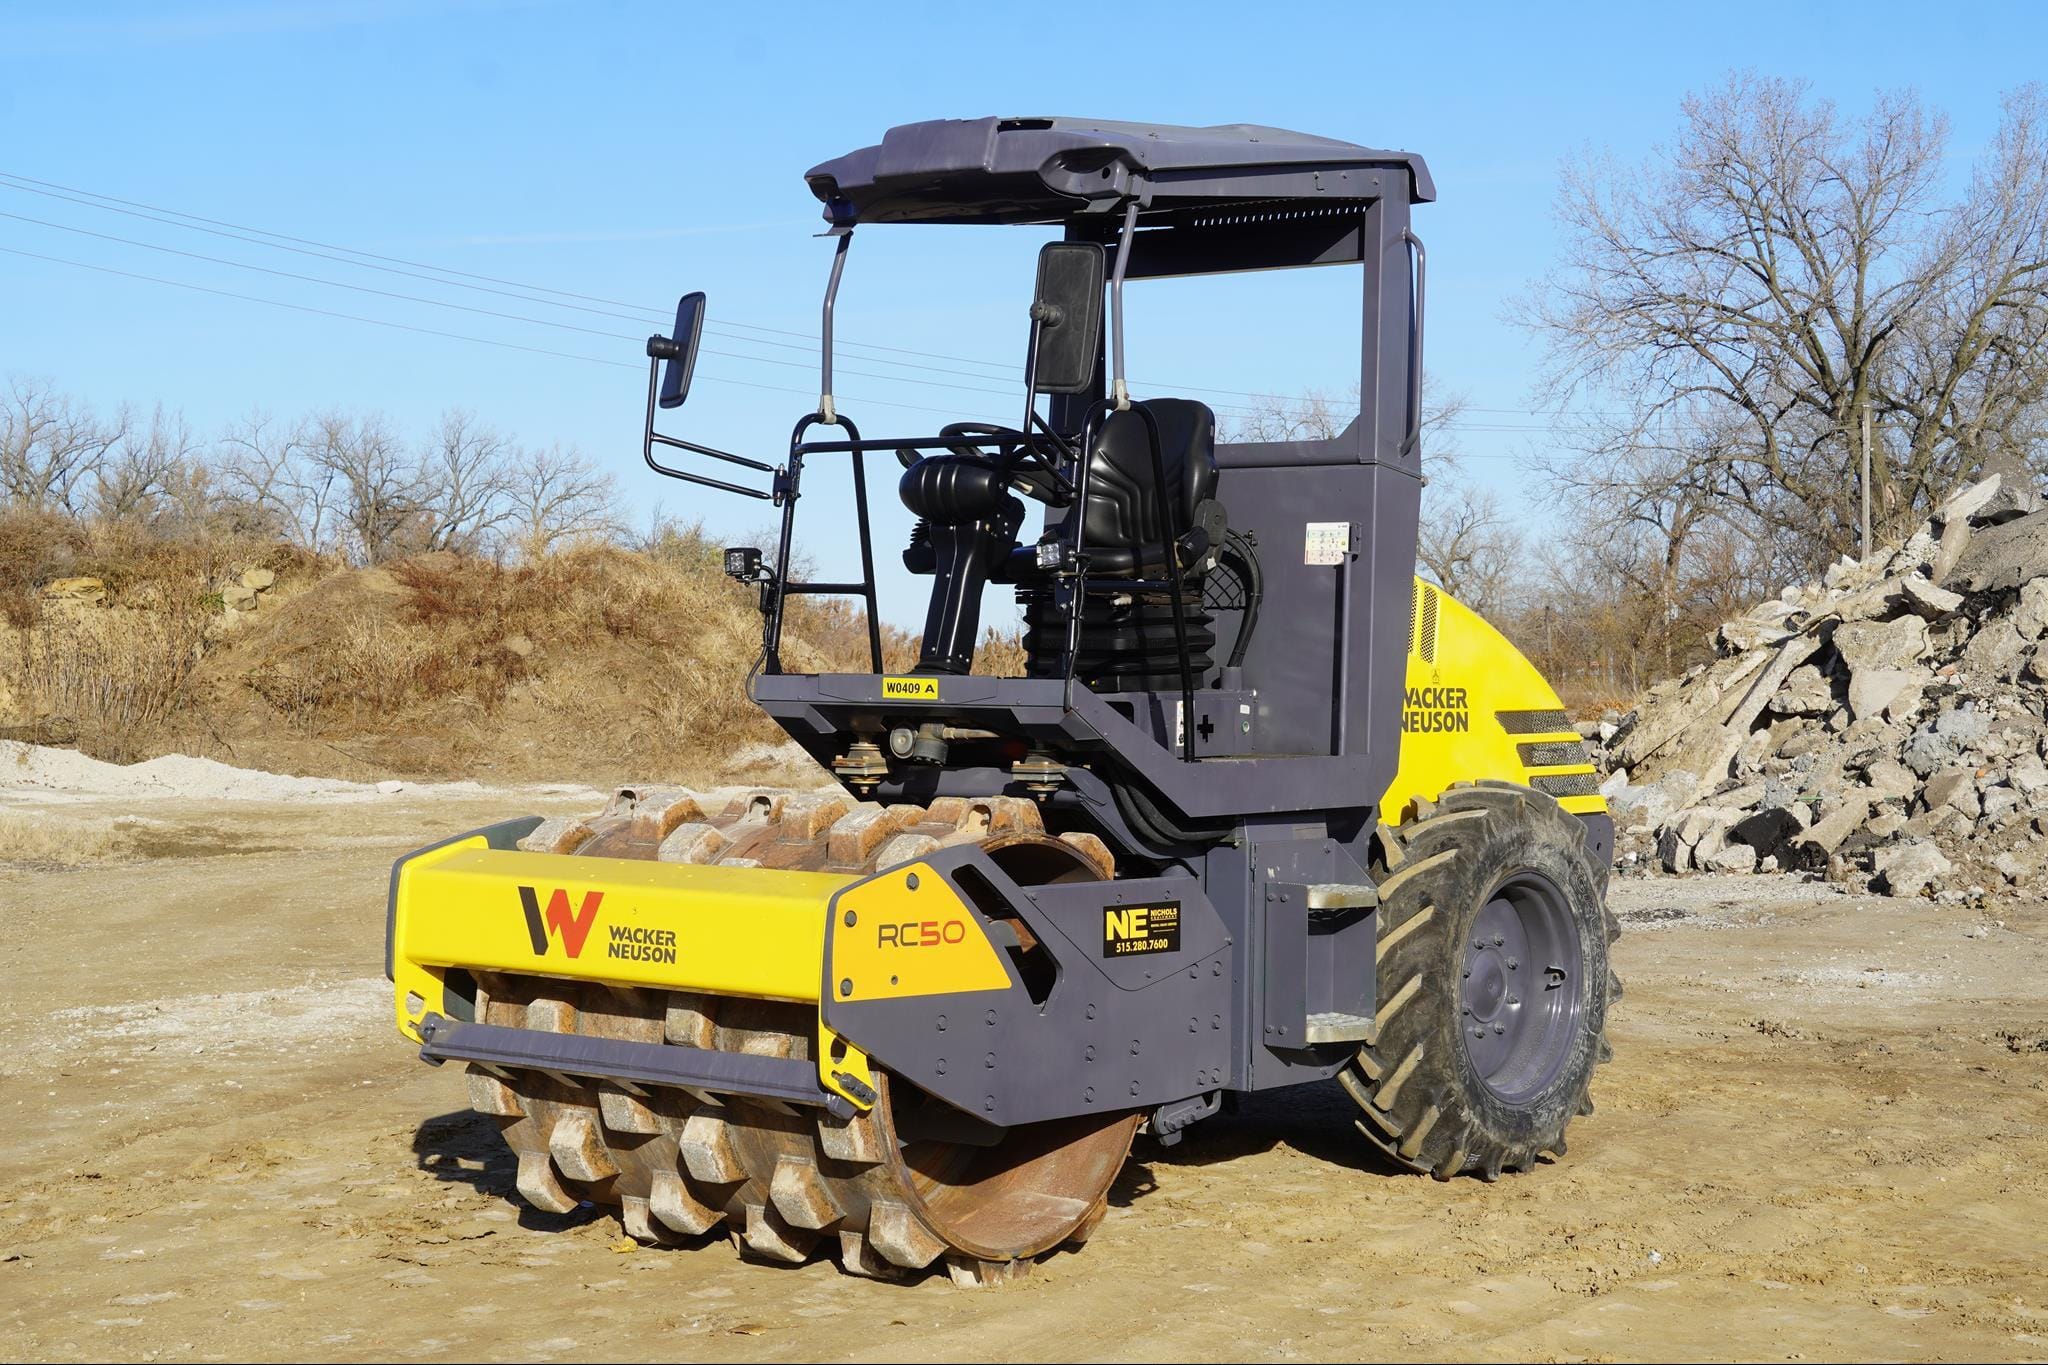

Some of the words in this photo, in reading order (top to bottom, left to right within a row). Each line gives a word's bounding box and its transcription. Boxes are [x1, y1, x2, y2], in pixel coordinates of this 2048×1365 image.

[887, 682, 920, 693] W0409
[925, 684, 935, 693] A
[1150, 908, 1177, 917] NICHOLS
[878, 920, 965, 949] RC50
[1106, 908, 1148, 941] NE
[608, 925, 677, 947] WACKER
[1116, 939, 1168, 953] 515.280.7600
[608, 942, 676, 965] NEUSON
